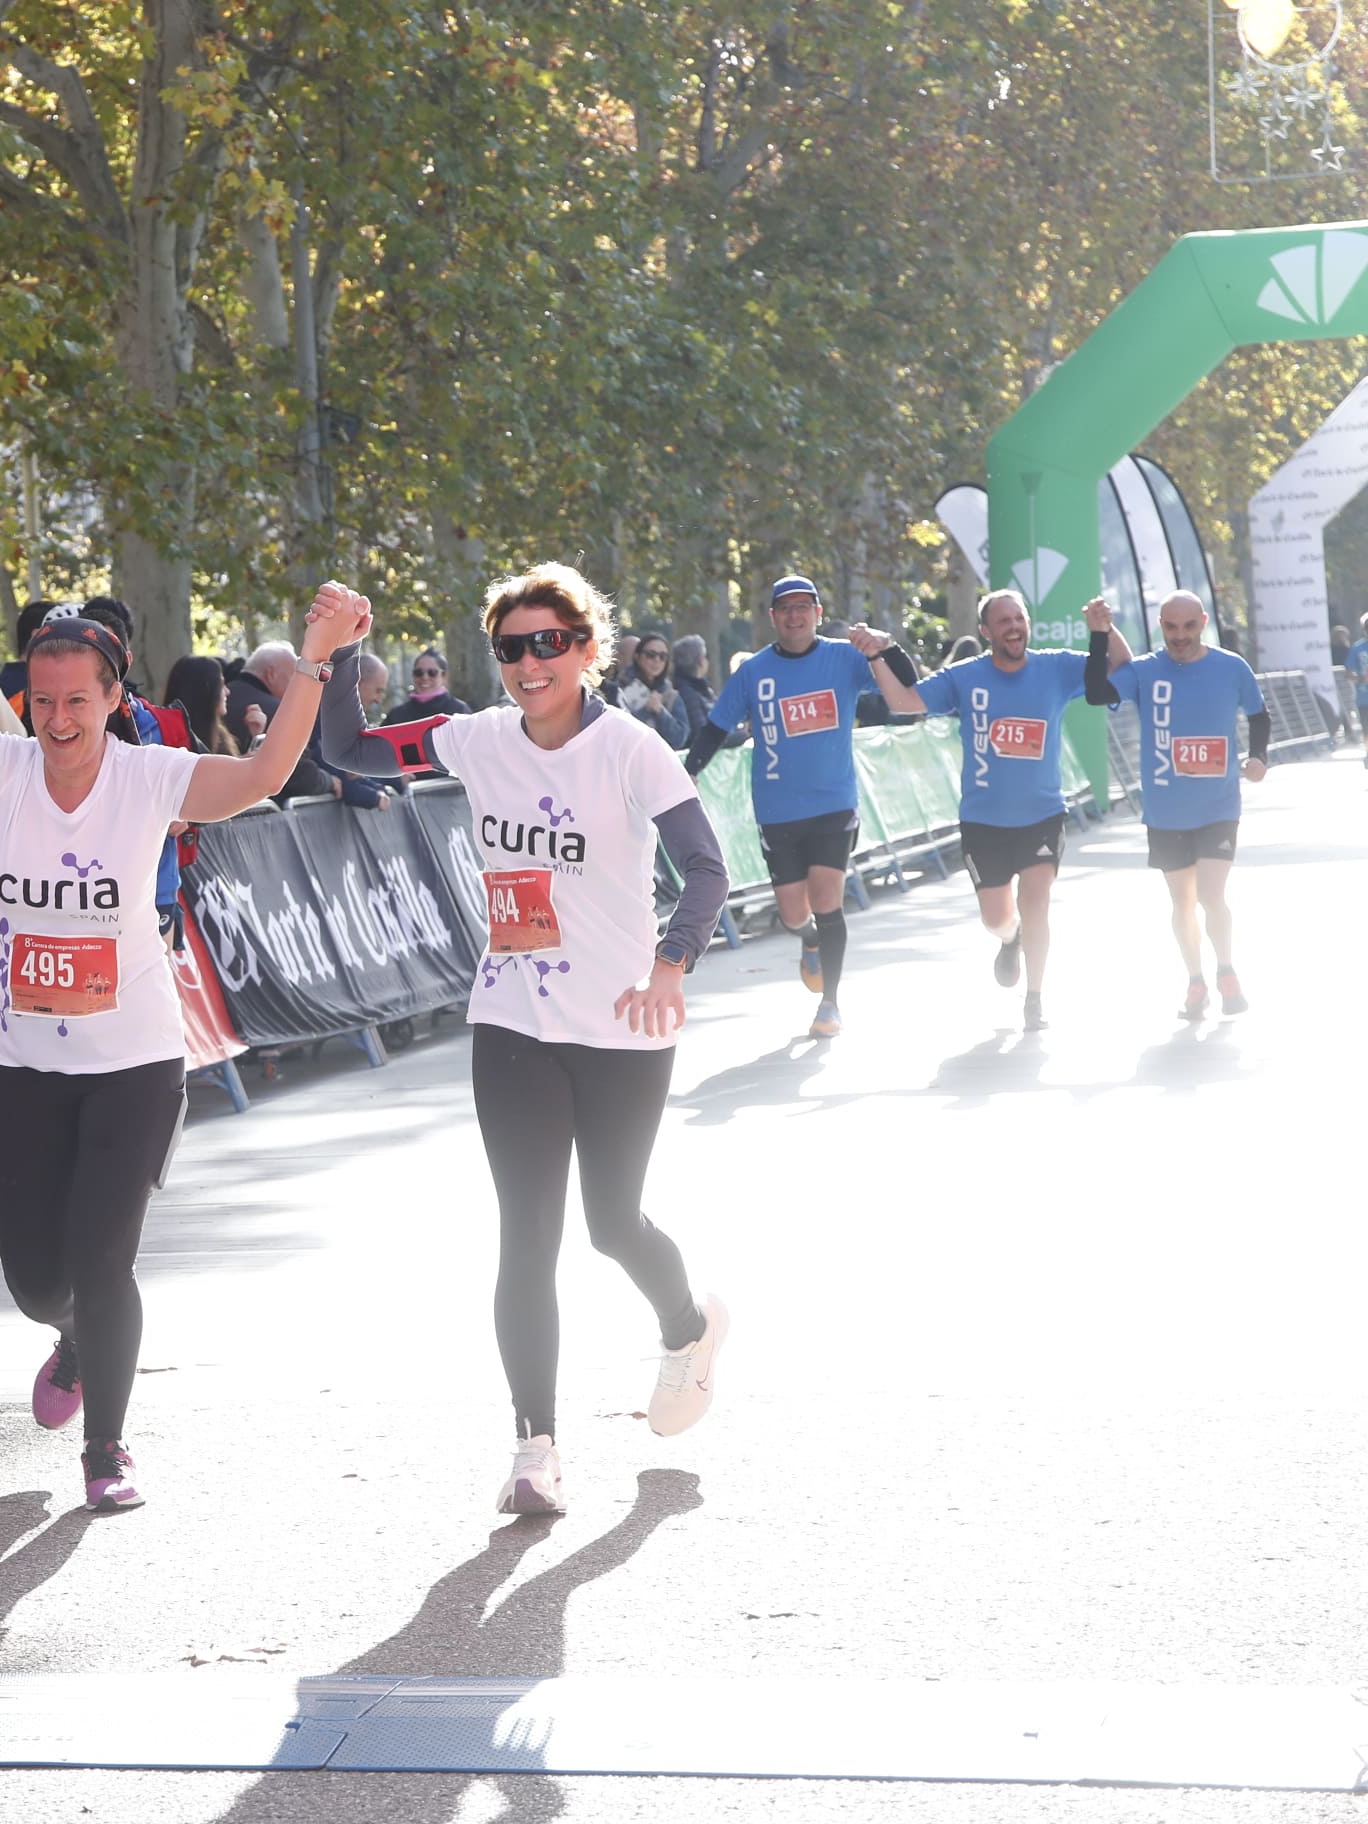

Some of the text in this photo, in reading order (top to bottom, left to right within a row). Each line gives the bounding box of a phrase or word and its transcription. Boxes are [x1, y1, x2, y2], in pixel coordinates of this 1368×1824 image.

[758, 678, 780, 780] IVECO
[788, 701, 818, 722] 214
[972, 687, 989, 788] IVECO
[996, 725, 1025, 744] 215
[1152, 680, 1172, 786] IVECO
[1179, 744, 1208, 763] 216
[481, 814, 586, 862] curia
[492, 887, 520, 923] 494
[20, 950, 74, 987] 495
